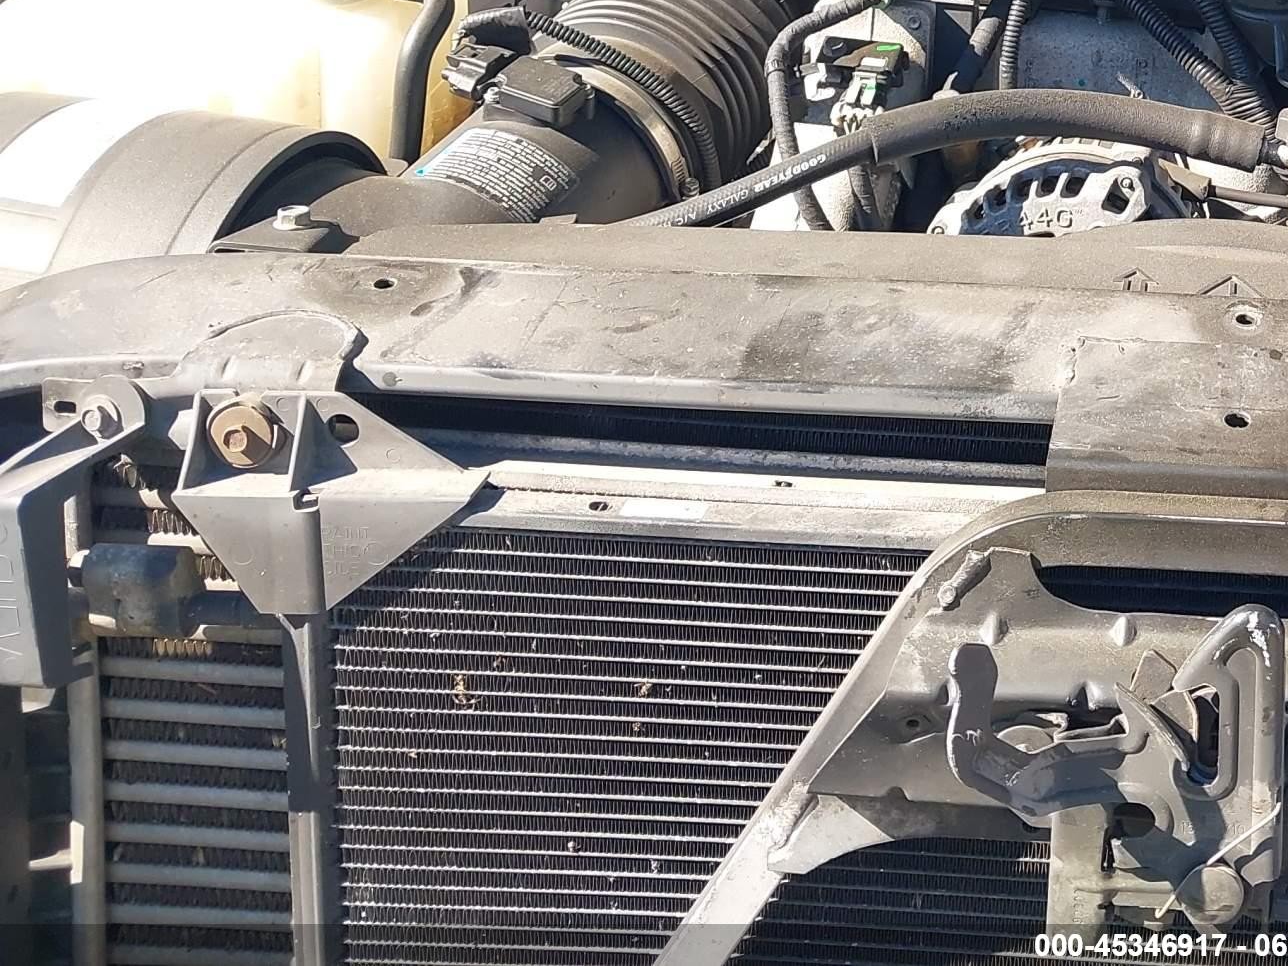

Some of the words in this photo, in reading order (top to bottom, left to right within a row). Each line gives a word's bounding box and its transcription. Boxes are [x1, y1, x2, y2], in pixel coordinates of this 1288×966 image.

[753, 154, 827, 192] GOODYEAR
[706, 188, 750, 214] GALAXY
[676, 210, 697, 226] A/C
